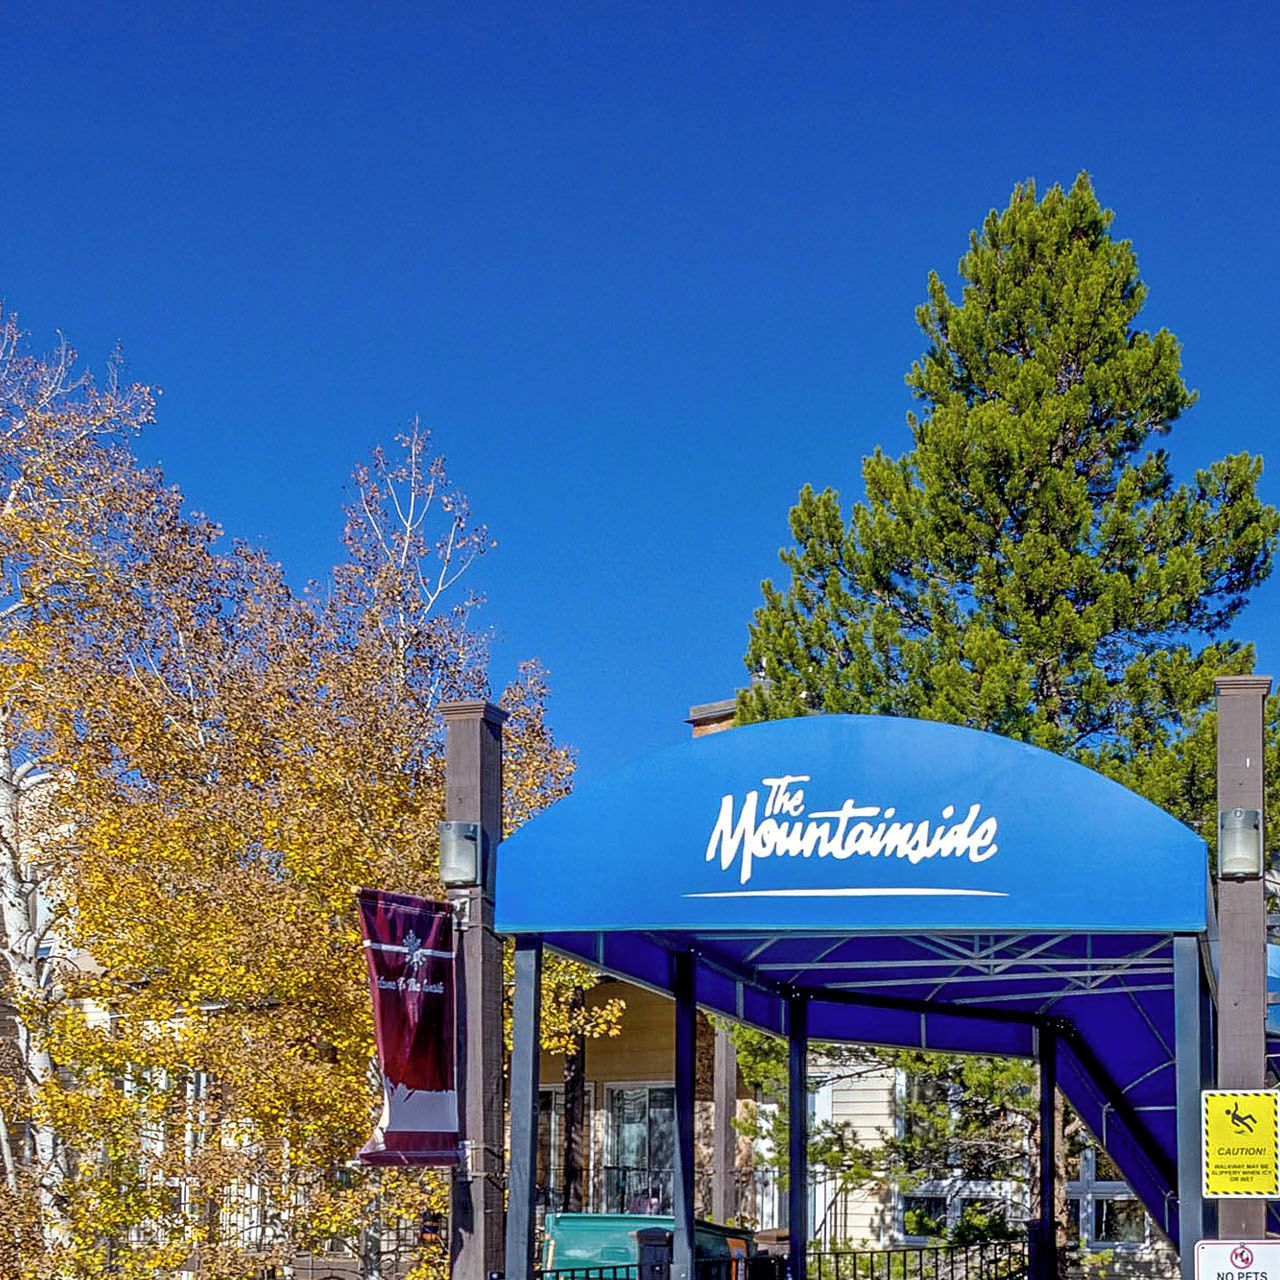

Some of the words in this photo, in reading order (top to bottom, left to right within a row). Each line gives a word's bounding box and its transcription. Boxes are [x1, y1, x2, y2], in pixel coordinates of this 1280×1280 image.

[762, 775, 810, 817] The
[706, 790, 998, 885] Mountainside
[1217, 1146, 1267, 1156] CAUTION!
